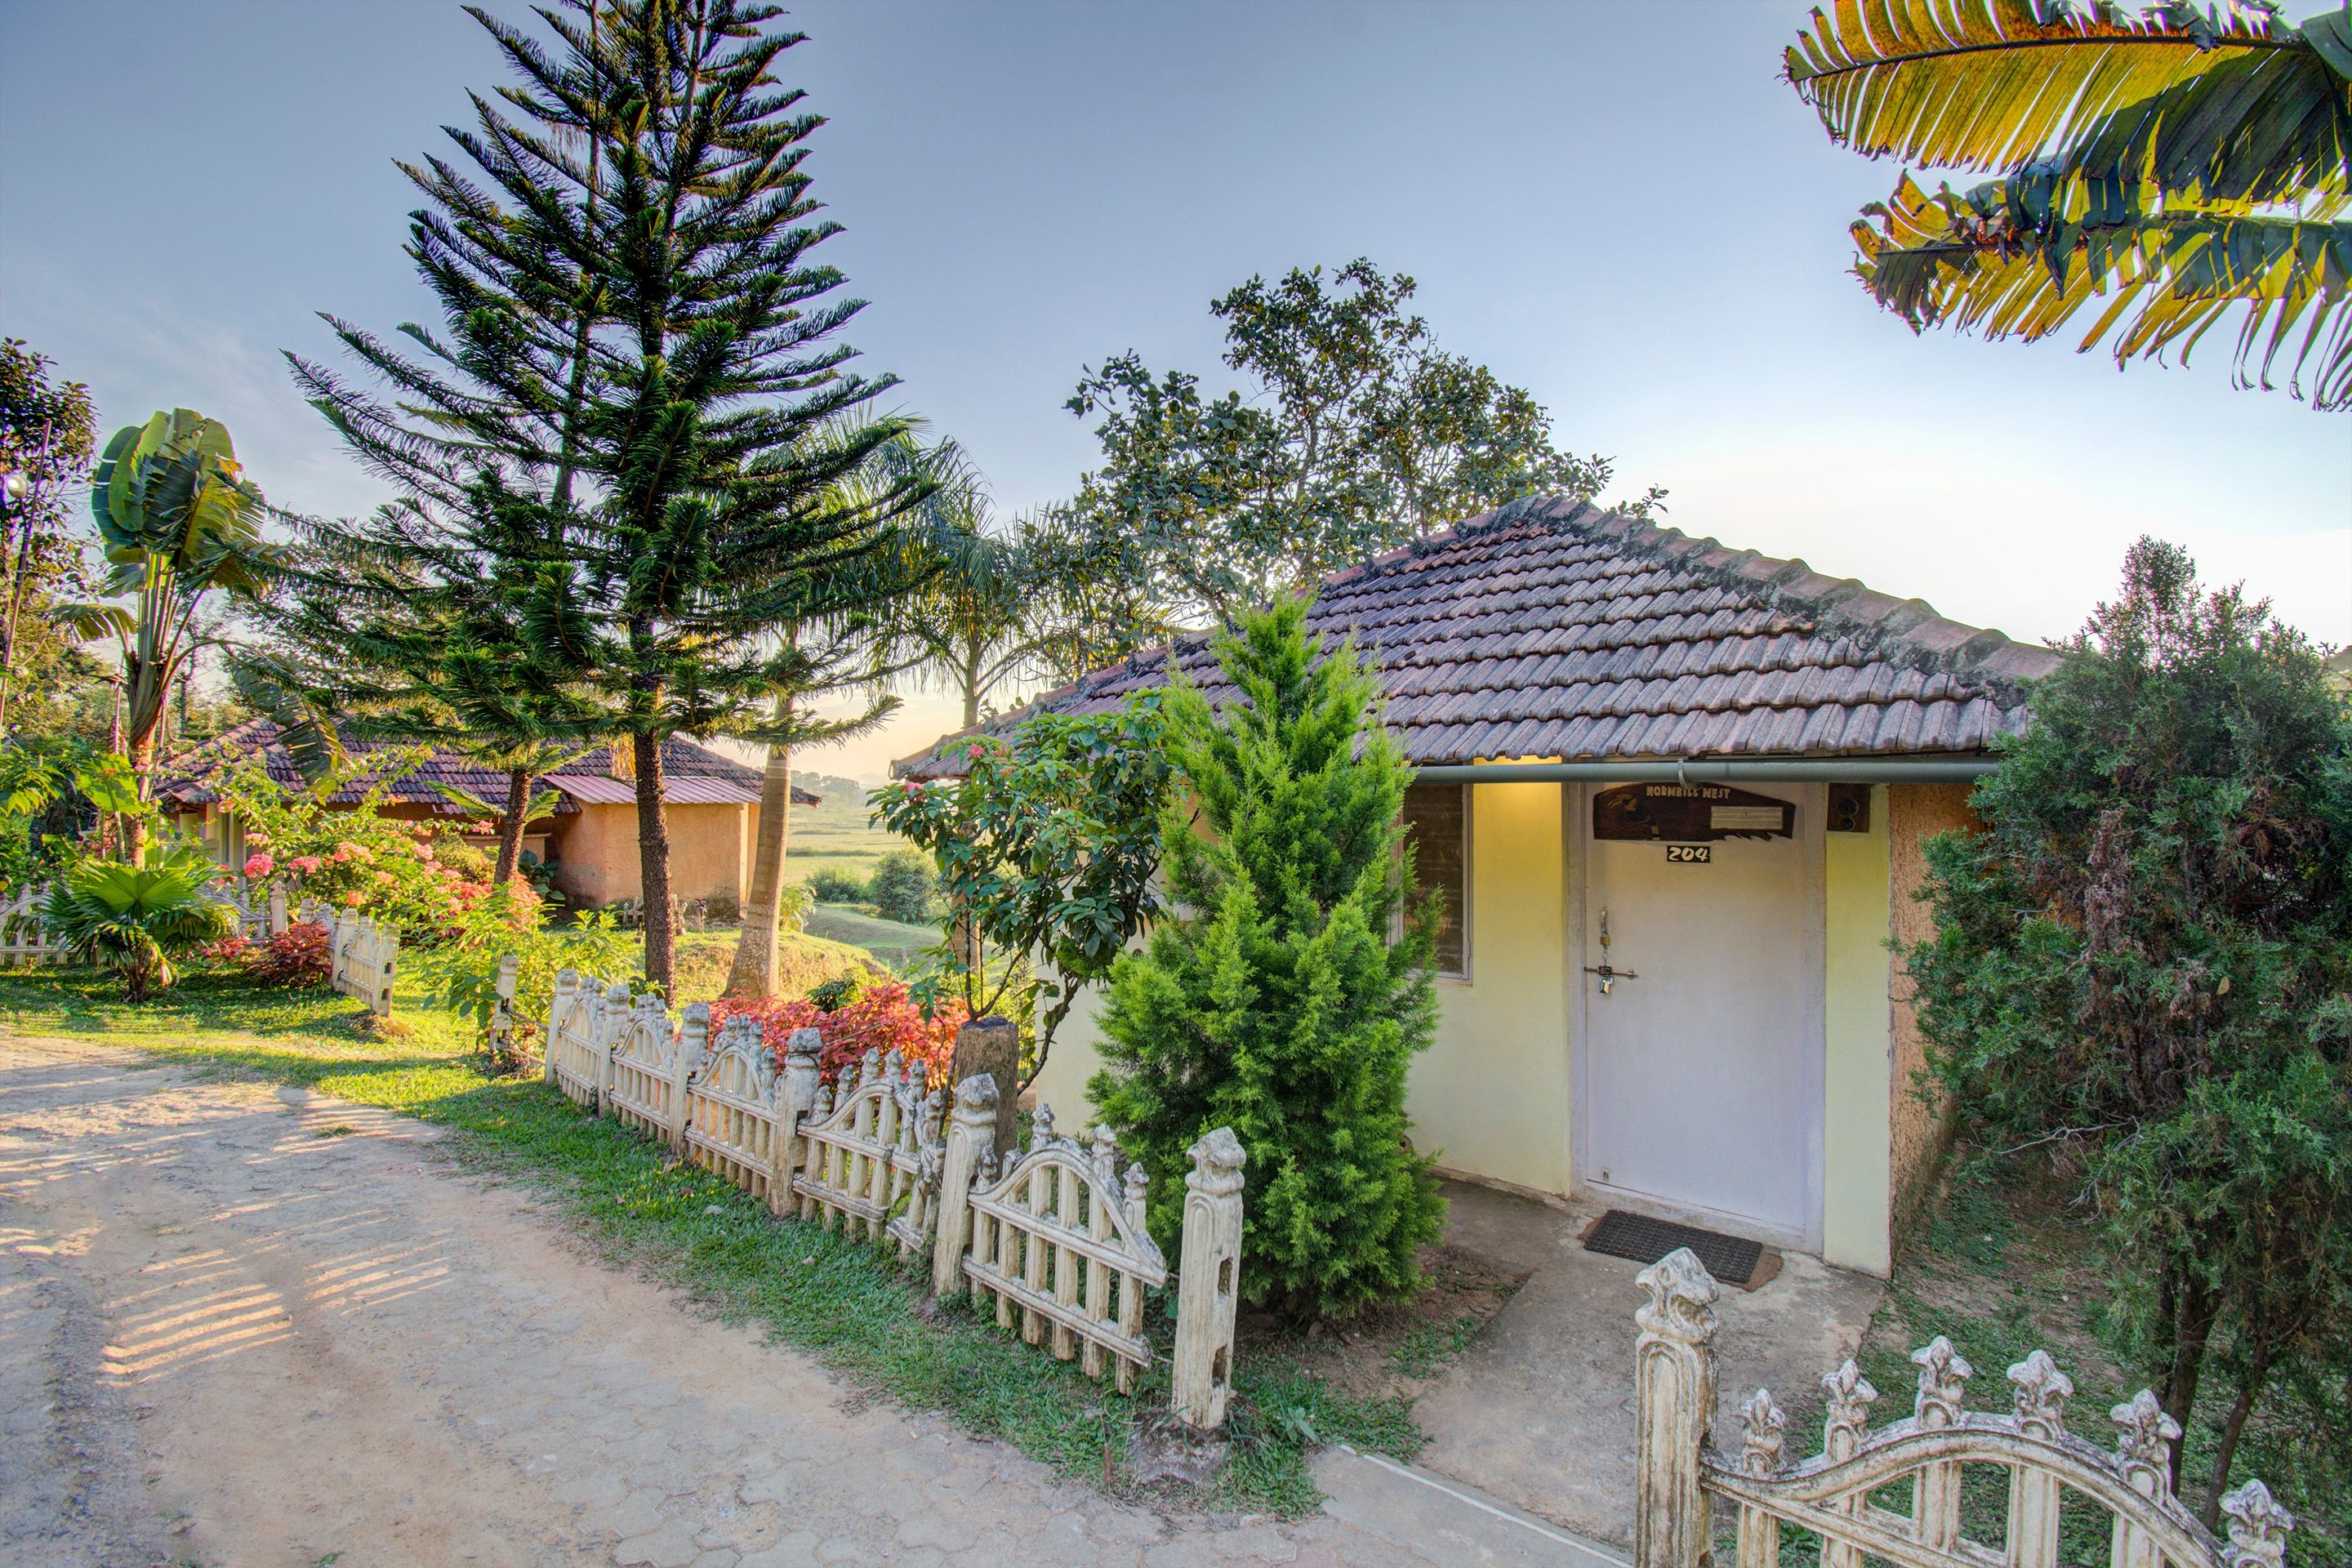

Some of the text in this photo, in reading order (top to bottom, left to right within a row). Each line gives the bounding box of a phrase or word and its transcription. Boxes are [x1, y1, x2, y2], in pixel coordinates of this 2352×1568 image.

[1646, 786, 1731, 799] HORNBILL NEST
[1668, 847, 1708, 862] 204
